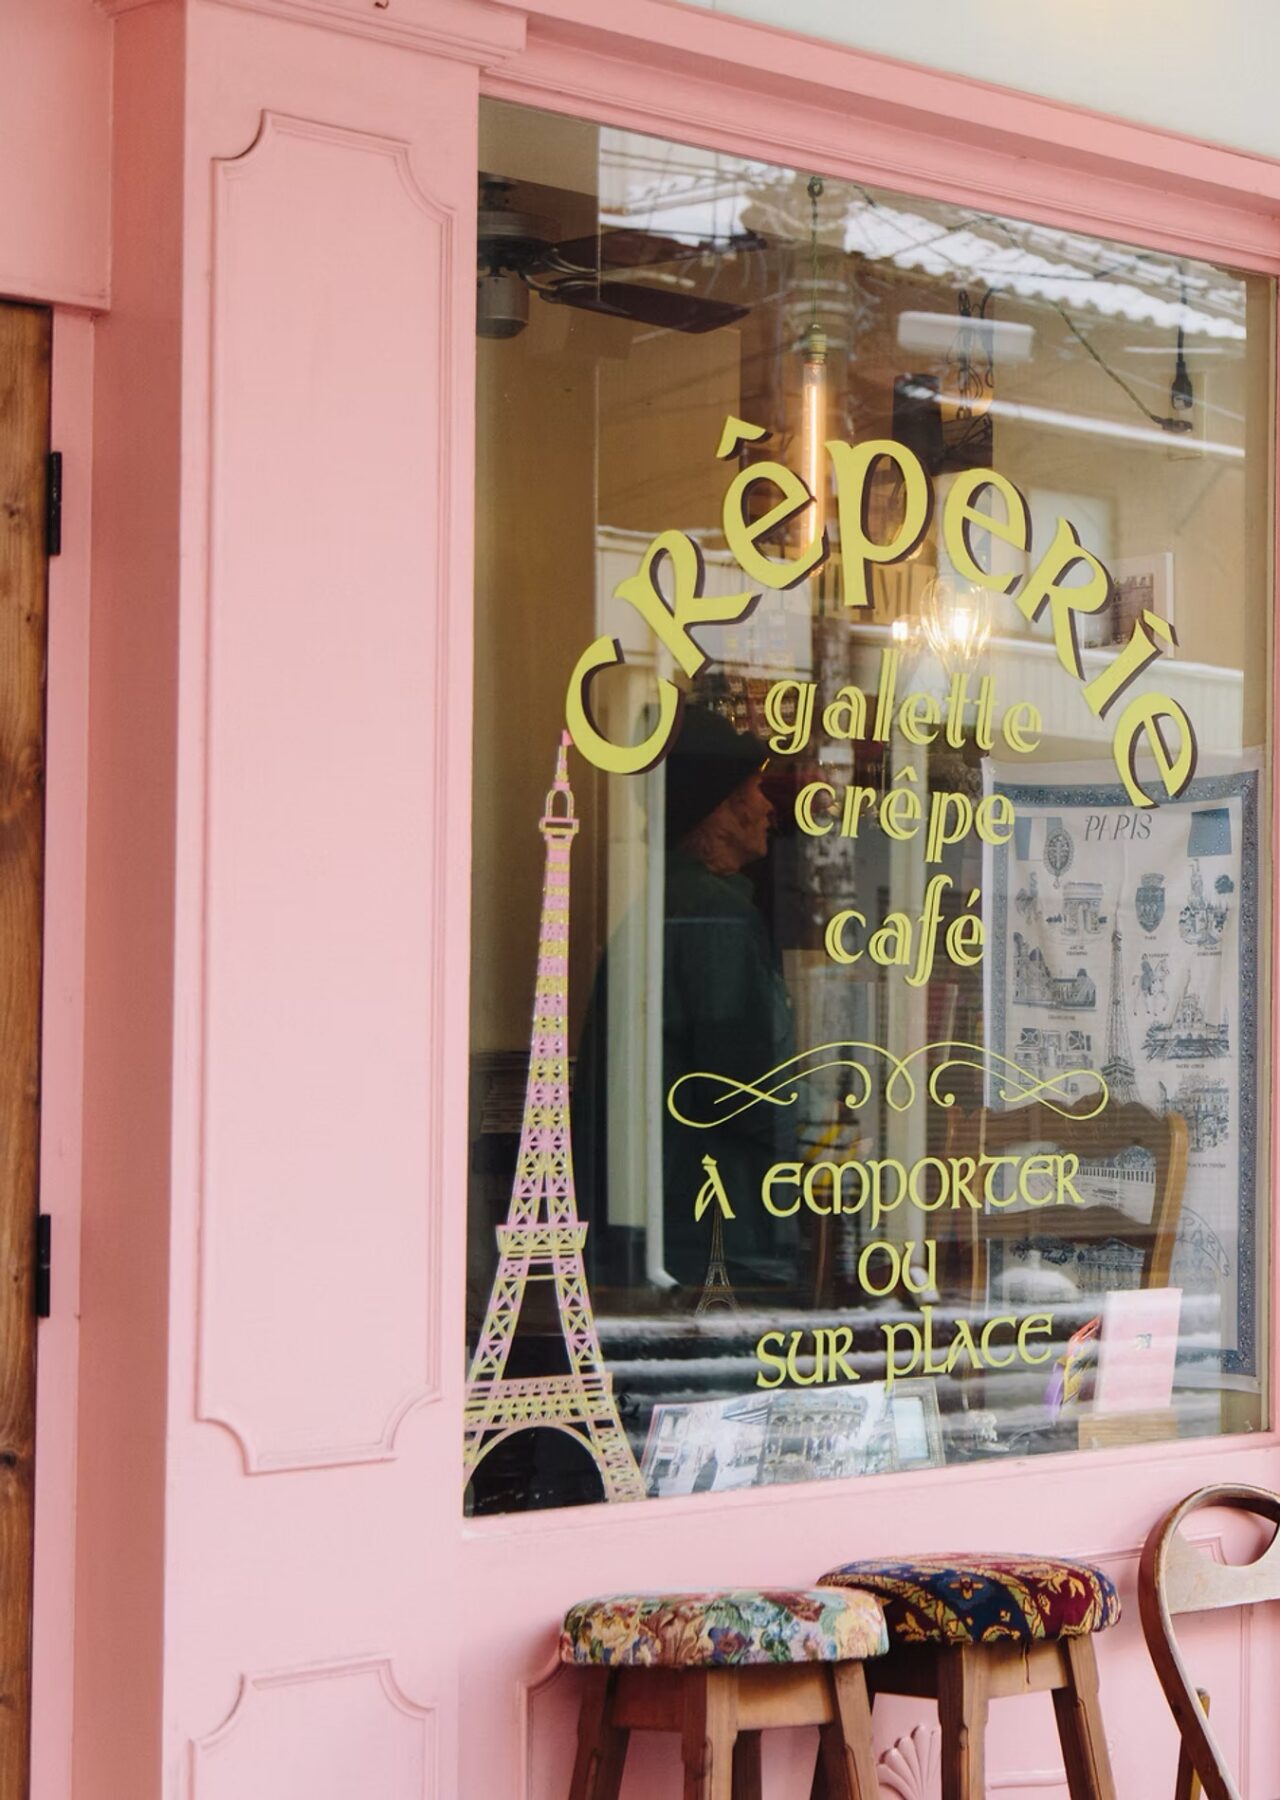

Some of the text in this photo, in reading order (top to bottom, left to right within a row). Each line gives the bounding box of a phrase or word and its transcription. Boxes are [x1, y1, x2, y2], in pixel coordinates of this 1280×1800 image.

[764, 648, 1042, 756] galette
[794, 765, 1015, 864] crêpe
[1084, 813, 1153, 841] PARIS
[824, 873, 986, 988] café
[694, 1153, 736, 1222] À
